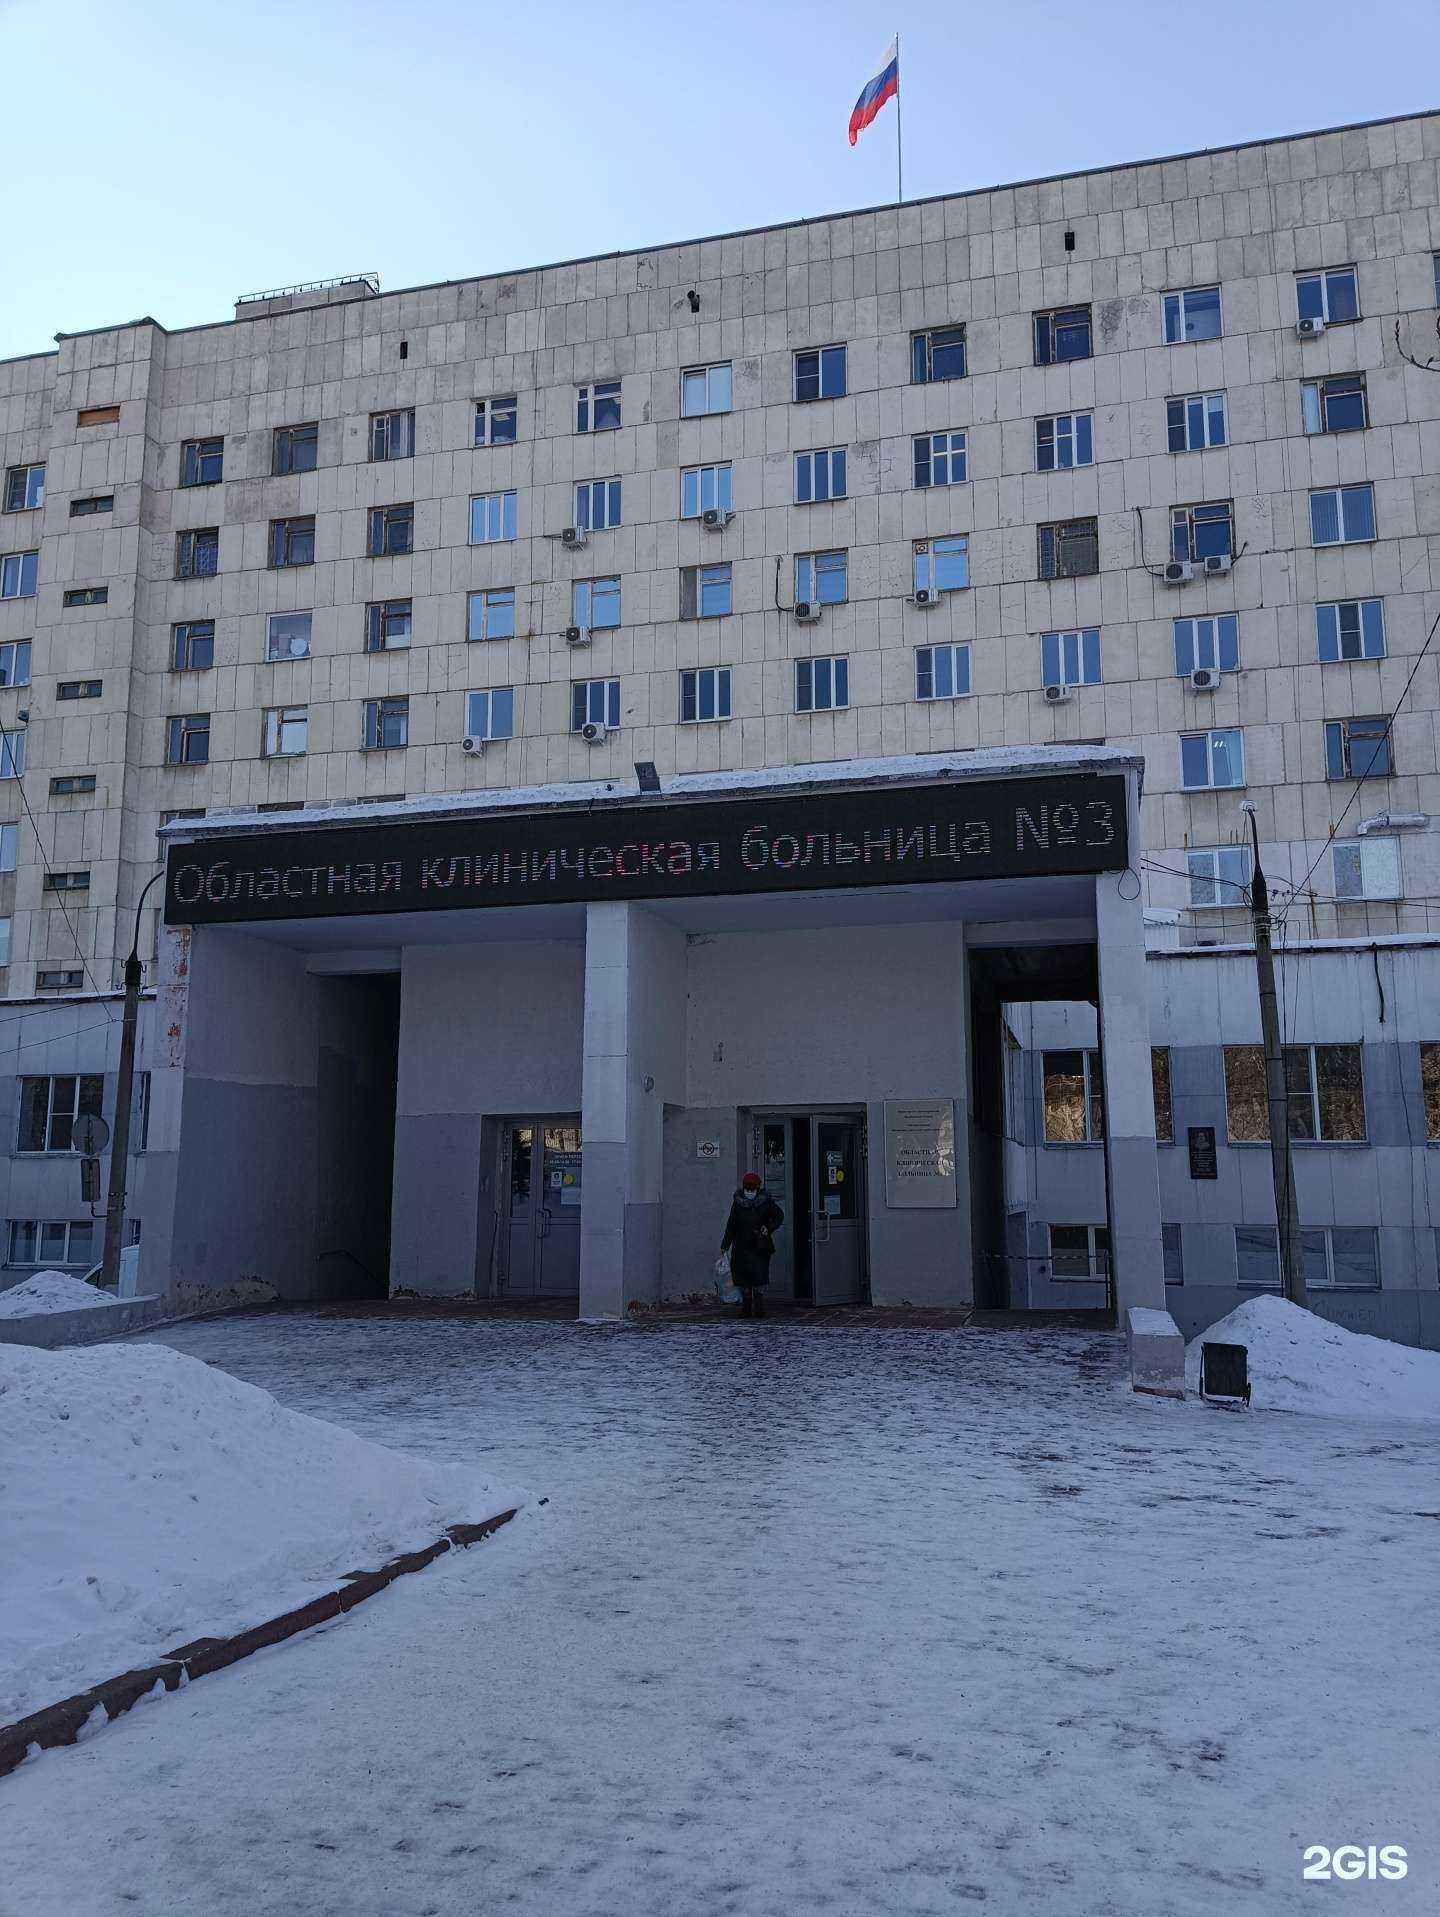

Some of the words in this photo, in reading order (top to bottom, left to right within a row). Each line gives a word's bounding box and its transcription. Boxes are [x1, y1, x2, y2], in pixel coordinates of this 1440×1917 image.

[173, 862, 402, 903] Областная
[421, 842, 721, 888] клиническая
[740, 821, 991, 870] больница
